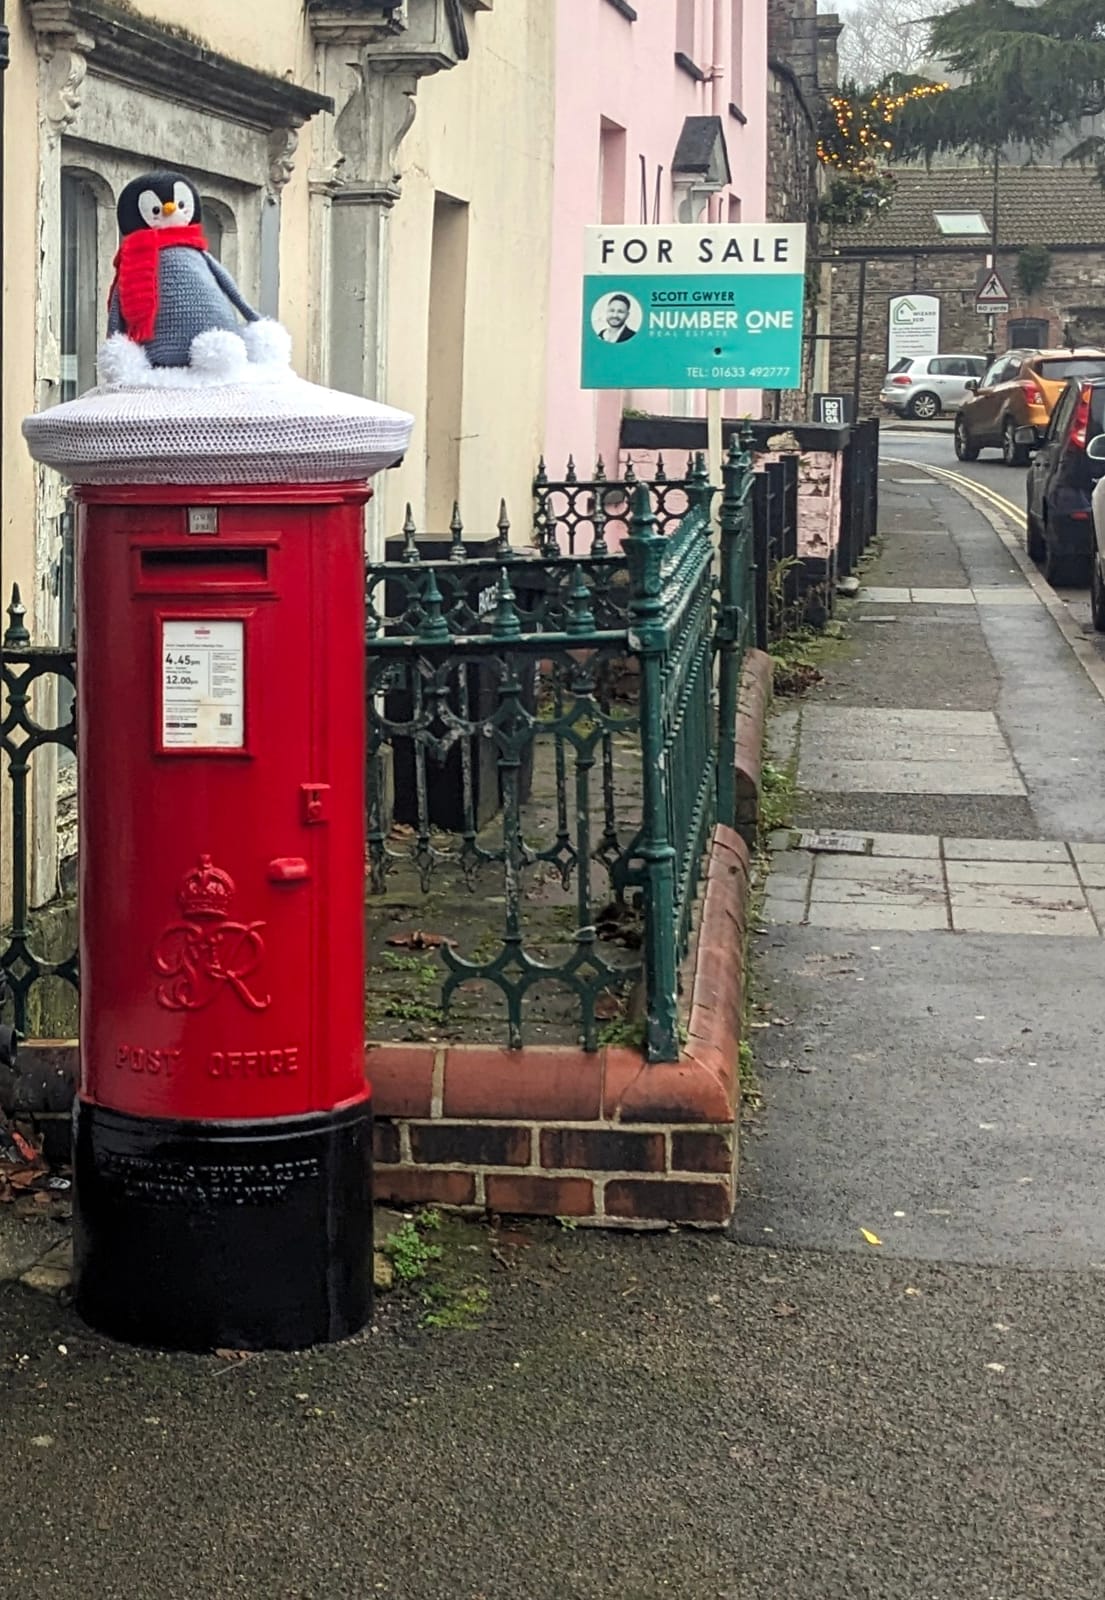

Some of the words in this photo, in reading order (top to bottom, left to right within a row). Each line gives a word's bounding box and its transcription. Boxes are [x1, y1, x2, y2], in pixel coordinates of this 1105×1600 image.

[601, 238, 673, 264] FOR
[698, 237, 789, 263] SALE
[651, 291, 688, 302] SCOTT
[692, 291, 735, 301] GWYER
[649, 310, 738, 329] NUMBER
[745, 310, 794, 330] ONE
[686, 367, 707, 377] TEL:
[712, 367, 745, 378] 01633
[749, 367, 790, 377] 492777
[165, 652, 200, 666] 4.45pm
[165, 675, 199, 685] 12.00pm
[115, 1045, 182, 1077] POST
[208, 1047, 299, 1078] OFFICE
